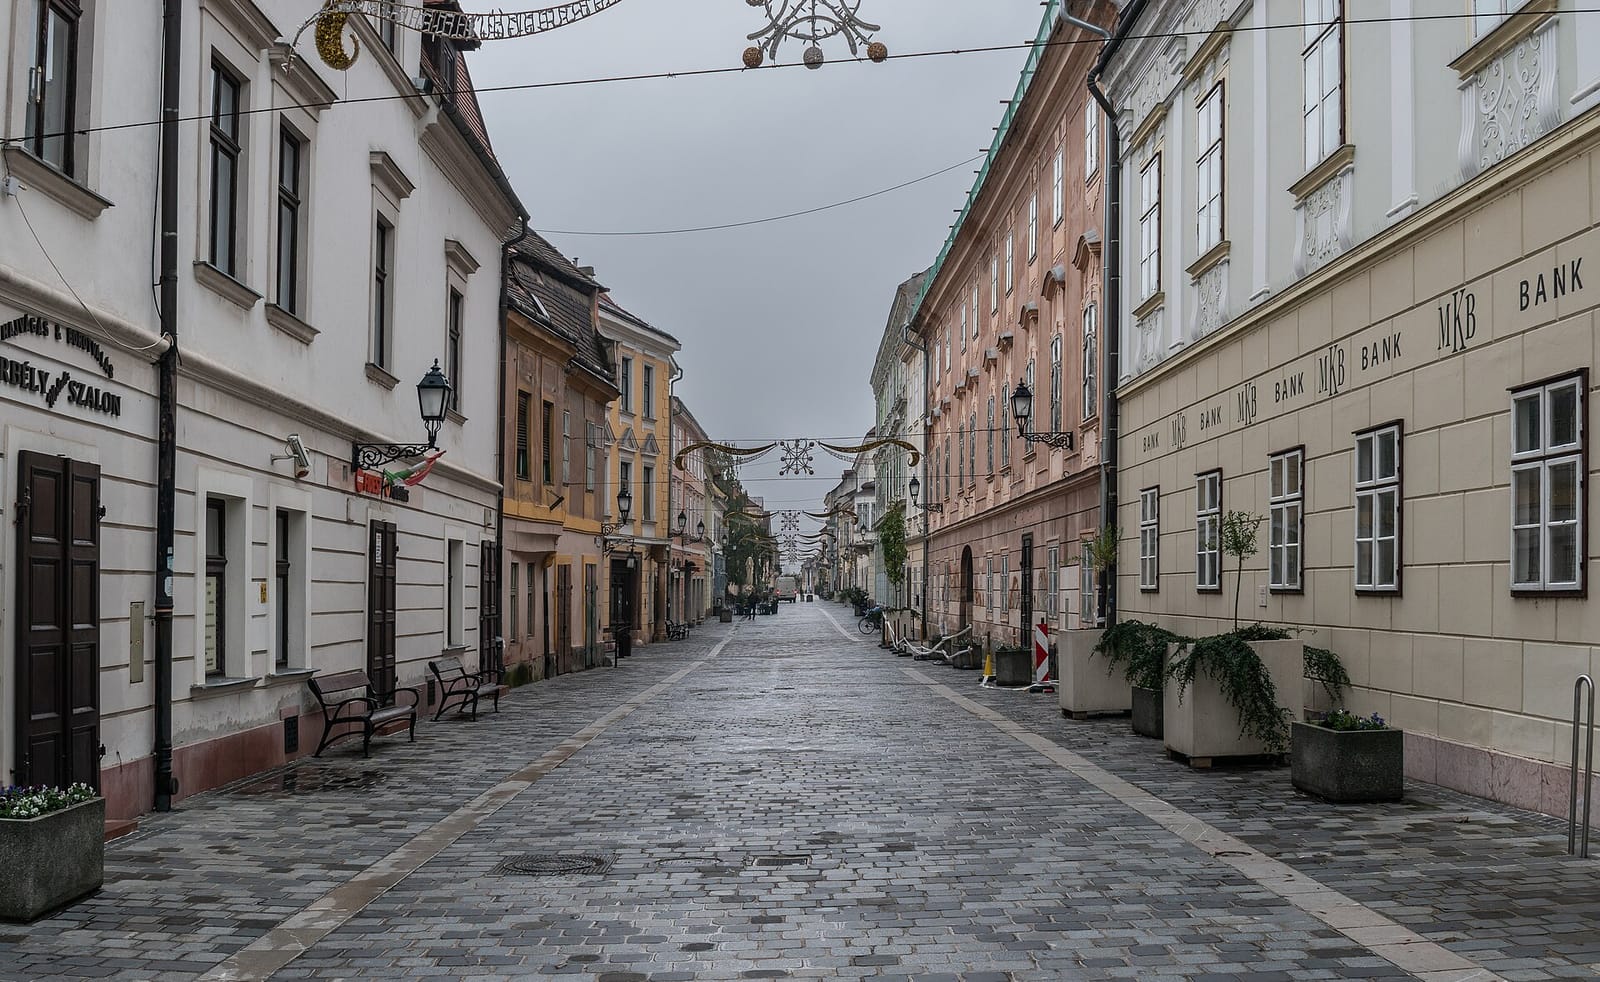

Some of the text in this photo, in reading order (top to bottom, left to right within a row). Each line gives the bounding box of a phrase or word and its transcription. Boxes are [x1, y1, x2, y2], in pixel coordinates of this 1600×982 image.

[67, 380, 121, 417] SZALON
[1143, 257, 1583, 453] BANK MKB BANK MKB BANK MKB BANK MKB BANK
